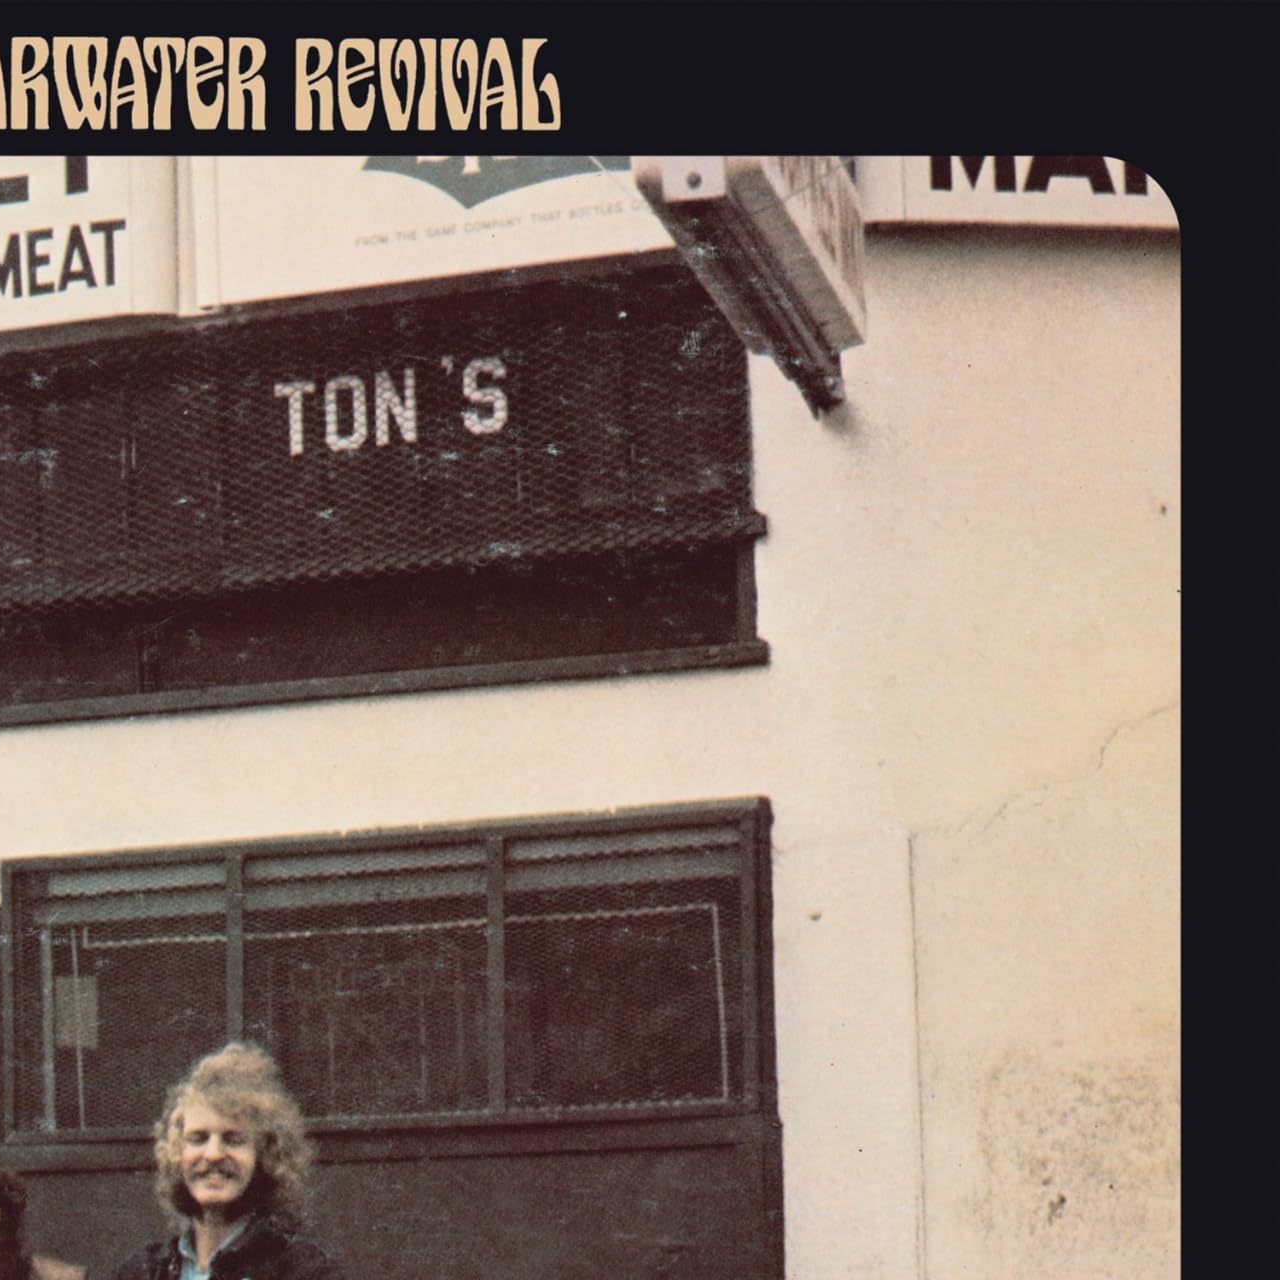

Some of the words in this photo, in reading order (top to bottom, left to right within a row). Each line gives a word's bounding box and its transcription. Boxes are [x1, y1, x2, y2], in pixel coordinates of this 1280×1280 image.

[395, 229, 418, 242] THE
[426, 223, 457, 238] SAME
[464, 217, 522, 233] COMPANY
[531, 212, 562, 225] THAT
